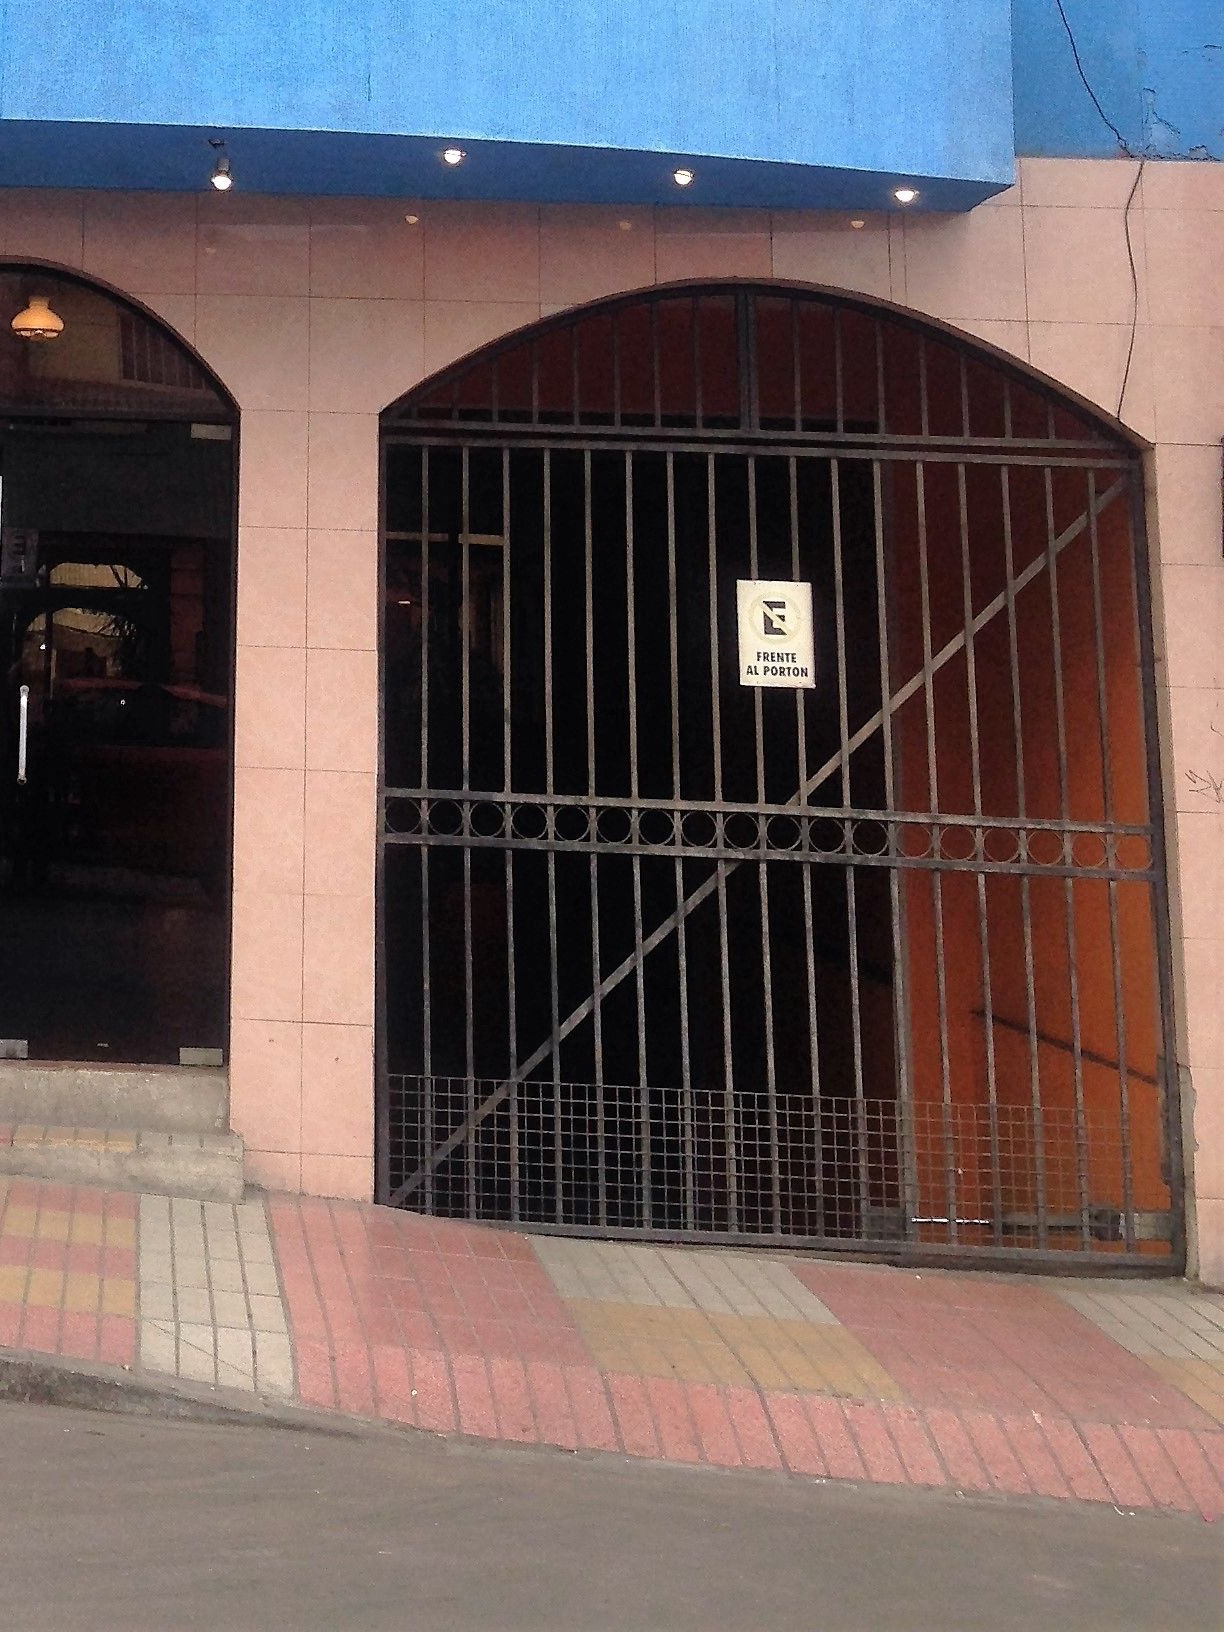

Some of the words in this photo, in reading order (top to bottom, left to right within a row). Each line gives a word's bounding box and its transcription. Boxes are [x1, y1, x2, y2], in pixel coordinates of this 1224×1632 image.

[756, 651, 797, 663] FRENTE
[746, 666, 759, 676] AL
[763, 666, 808, 678] PORTON
